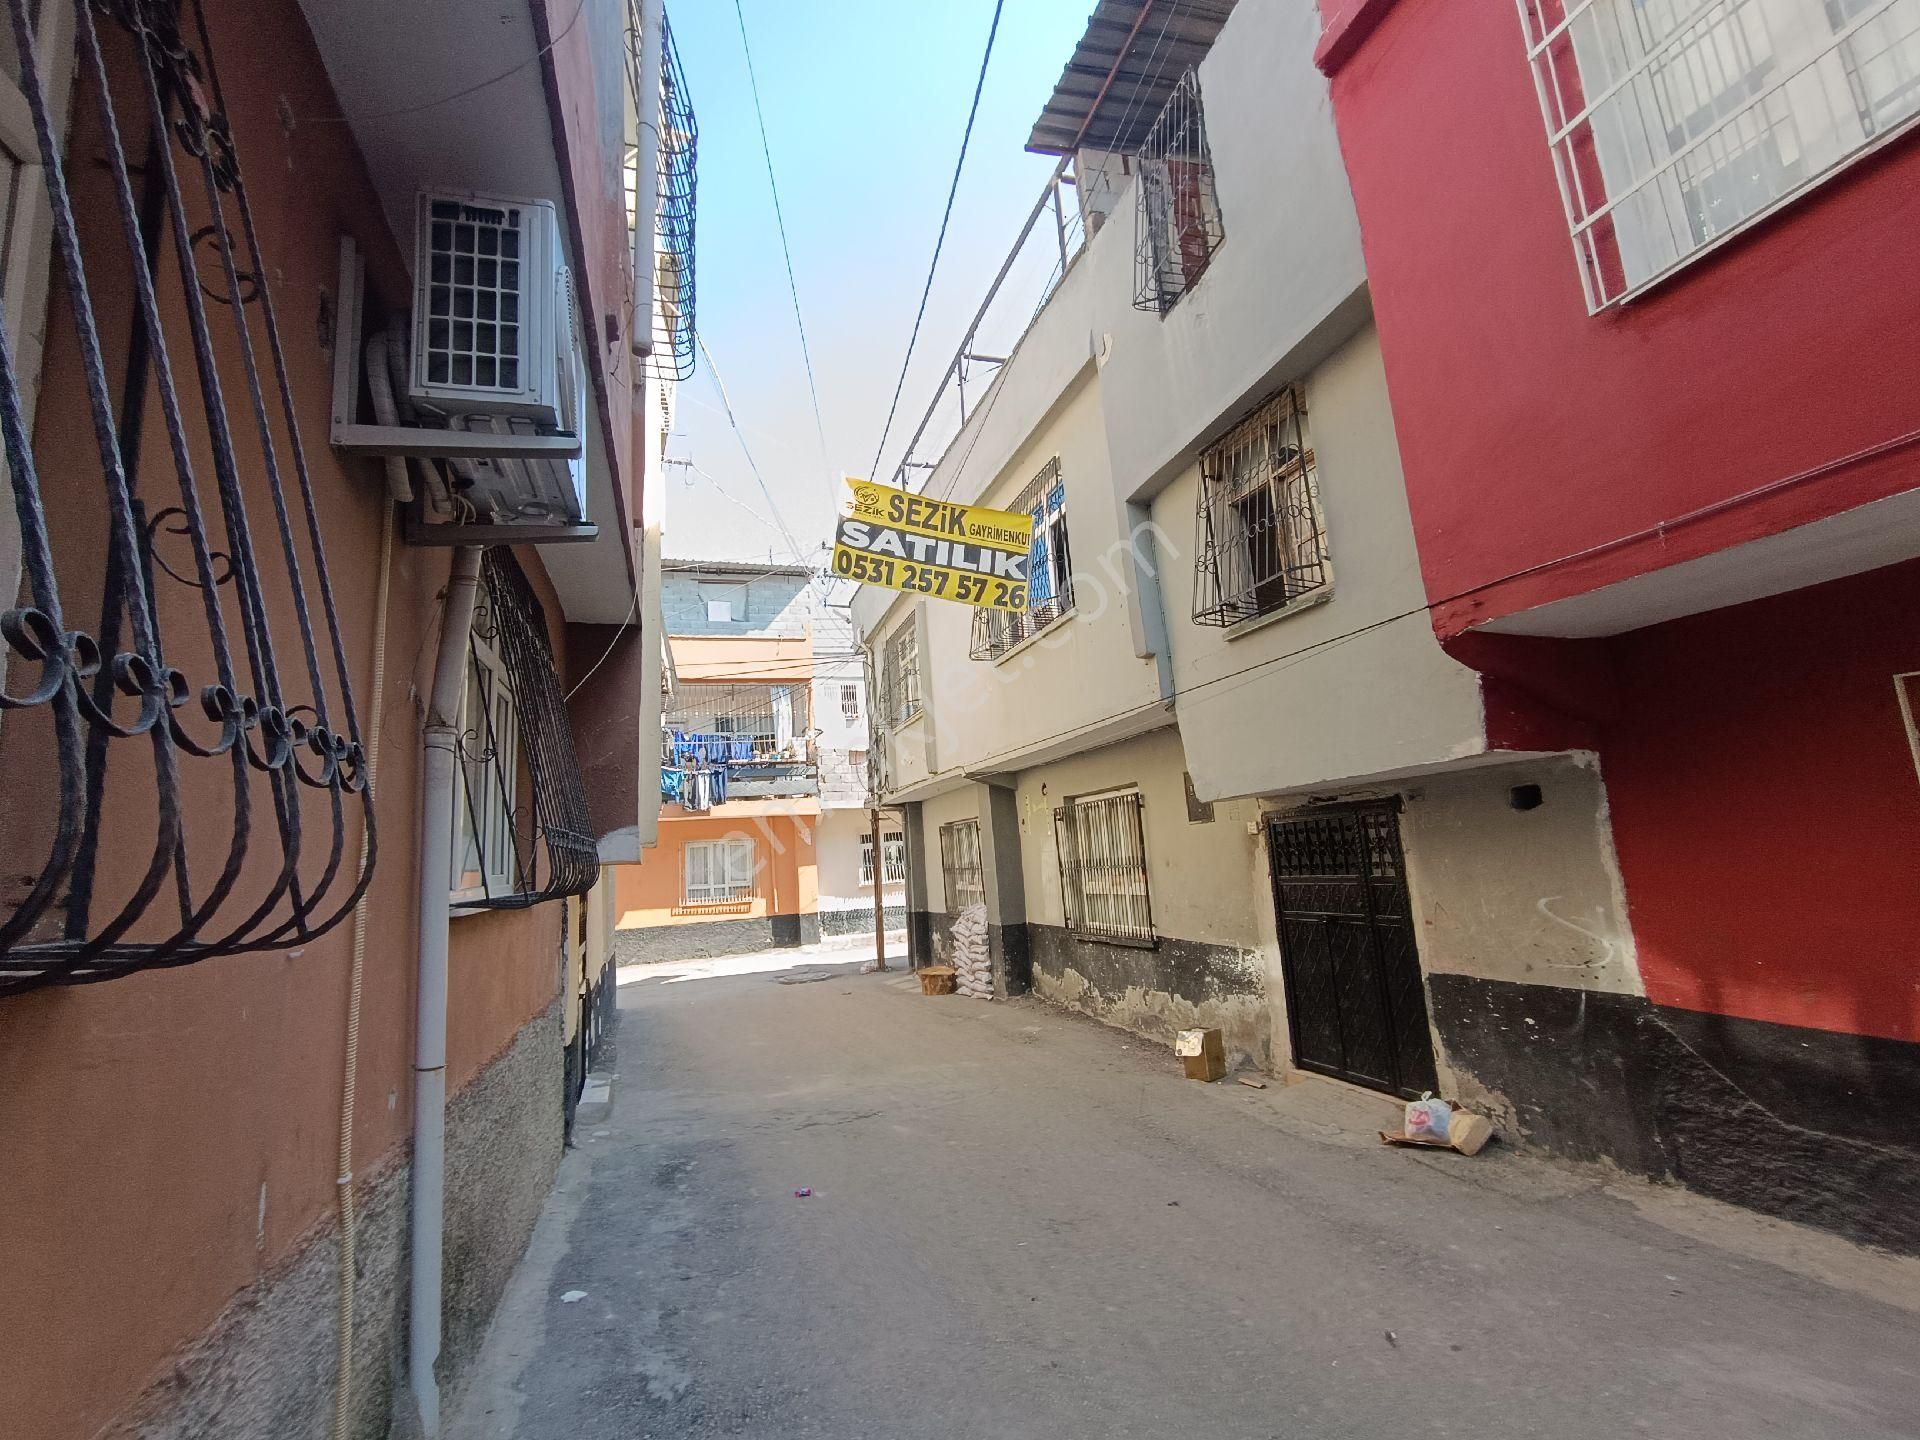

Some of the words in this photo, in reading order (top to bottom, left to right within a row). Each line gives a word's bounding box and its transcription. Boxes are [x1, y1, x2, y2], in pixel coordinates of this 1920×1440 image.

[837, 549, 895, 586] 0531
[902, 564, 950, 596] 257
[955, 575, 988, 603] 57
[993, 582, 1026, 609] 26
[840, 520, 1028, 580] SATILIK
